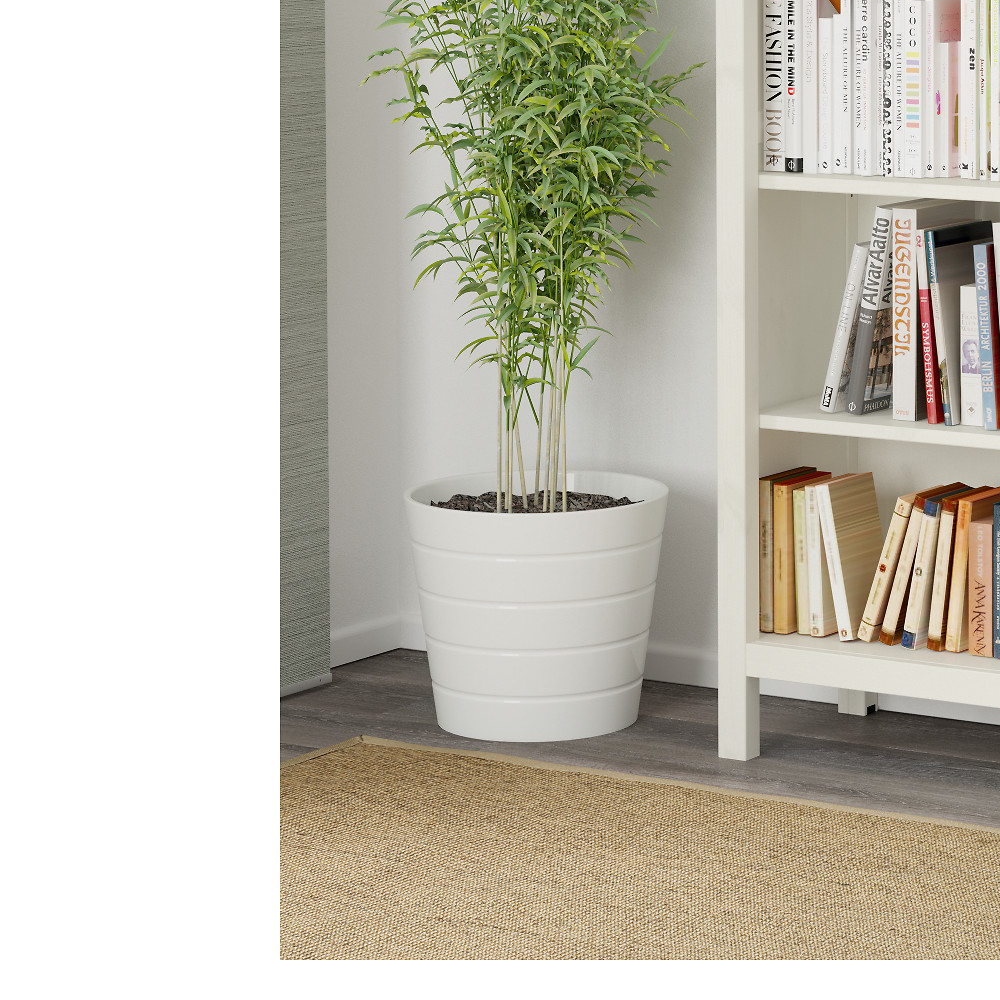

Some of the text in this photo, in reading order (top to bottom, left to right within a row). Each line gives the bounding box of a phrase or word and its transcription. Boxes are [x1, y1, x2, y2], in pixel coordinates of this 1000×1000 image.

[787, 29, 795, 41] IN
[787, 43, 795, 63] THE
[861, 25, 870, 62] cardin
[908, 5, 917, 48] COCO
[764, 13, 783, 103] FASHION
[787, 66, 795, 96] MIND
[764, 108, 783, 166] BOOK
[862, 218, 890, 306] Alvar Aalto
[895, 219, 911, 357] JUGENDSTIL
[976, 263, 993, 392] BERLIN ARCHITEKTUR 2000
[922, 323, 934, 404] SYMBOLISMUS
